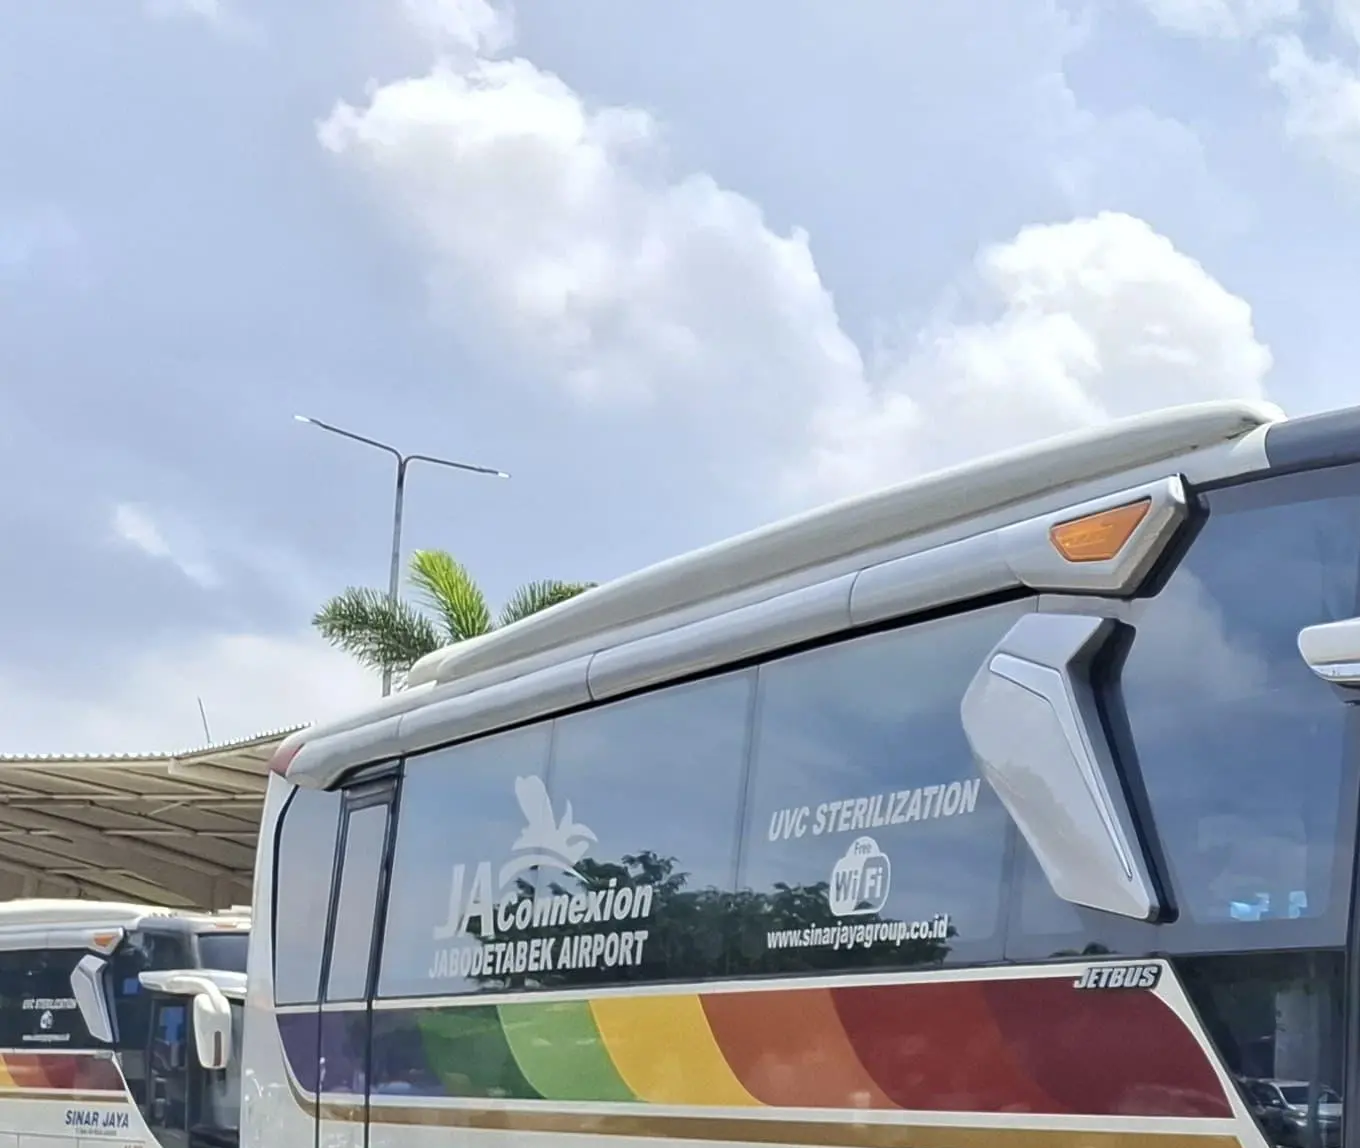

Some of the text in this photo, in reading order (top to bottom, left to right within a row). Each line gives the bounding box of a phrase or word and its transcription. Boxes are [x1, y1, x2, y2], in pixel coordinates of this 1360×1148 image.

[769, 779, 980, 842] UVC STERILIZATION
[767, 914, 948, 950] www.sinarjayagroup.co.id
[429, 931, 649, 978] JABODETABEK AIRPORT
[1074, 965, 1160, 989] JETBUS
[65, 1109, 129, 1129] SINAR JAYA
